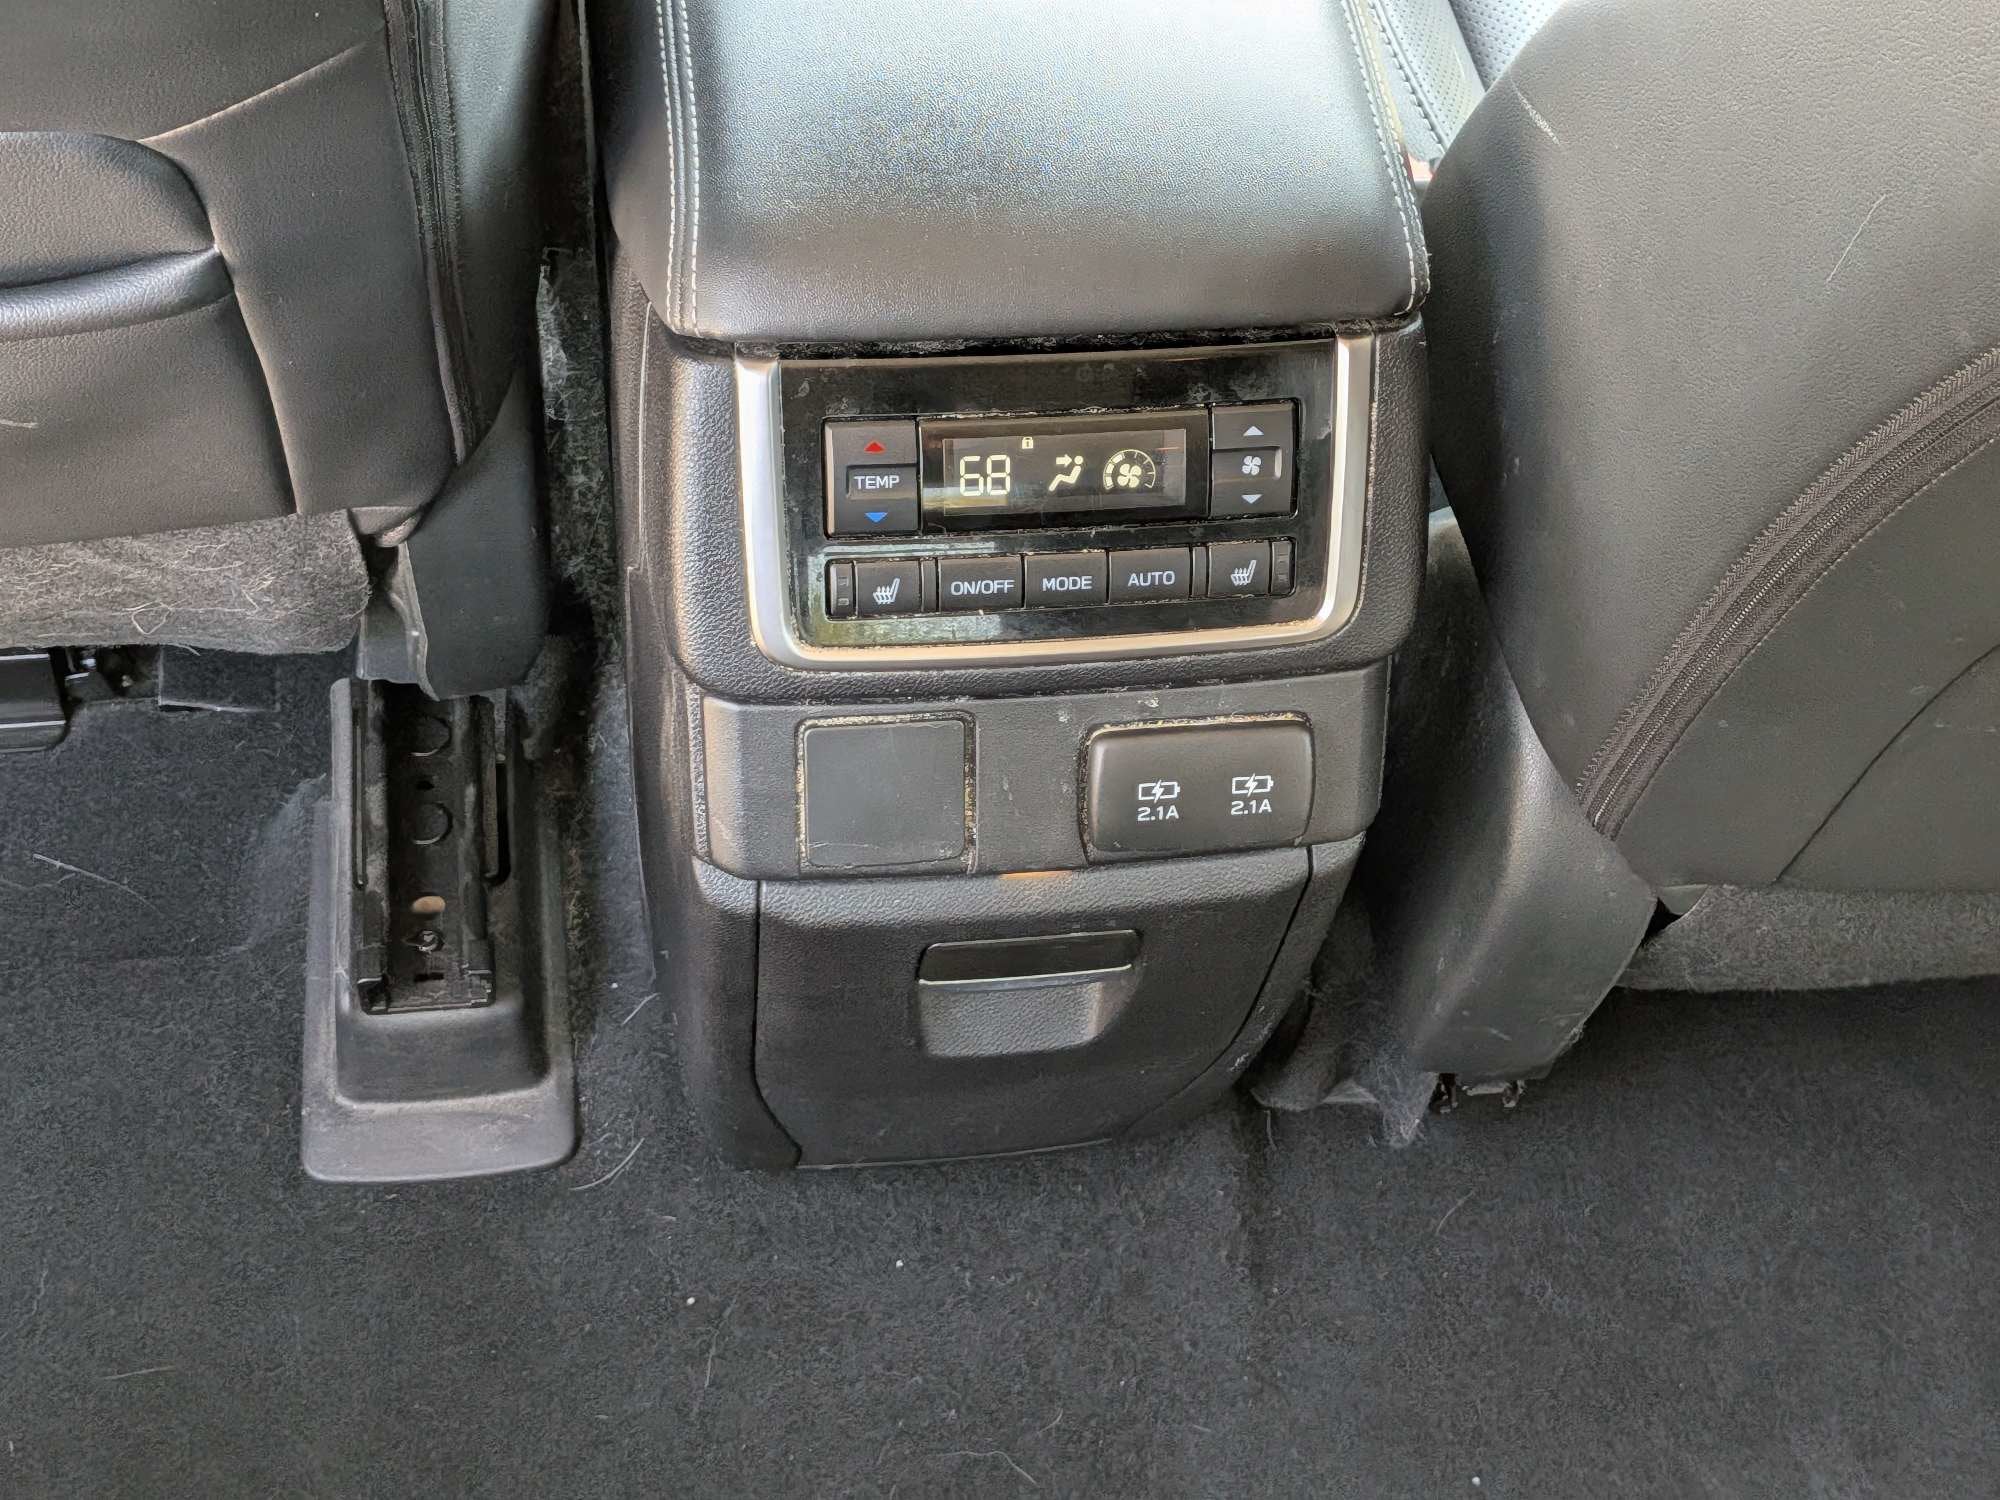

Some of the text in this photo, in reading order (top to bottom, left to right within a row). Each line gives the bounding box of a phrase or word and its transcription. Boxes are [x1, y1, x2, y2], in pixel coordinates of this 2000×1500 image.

[854, 474, 900, 490] TEMP
[959, 454, 1011, 496] 68
[1042, 575, 1093, 592] MODE
[1127, 570, 1176, 587] AUTO
[950, 579, 1015, 596] ON/OFF
[1137, 805, 1180, 821] 2.1A
[1231, 799, 1273, 815] 2.1A
